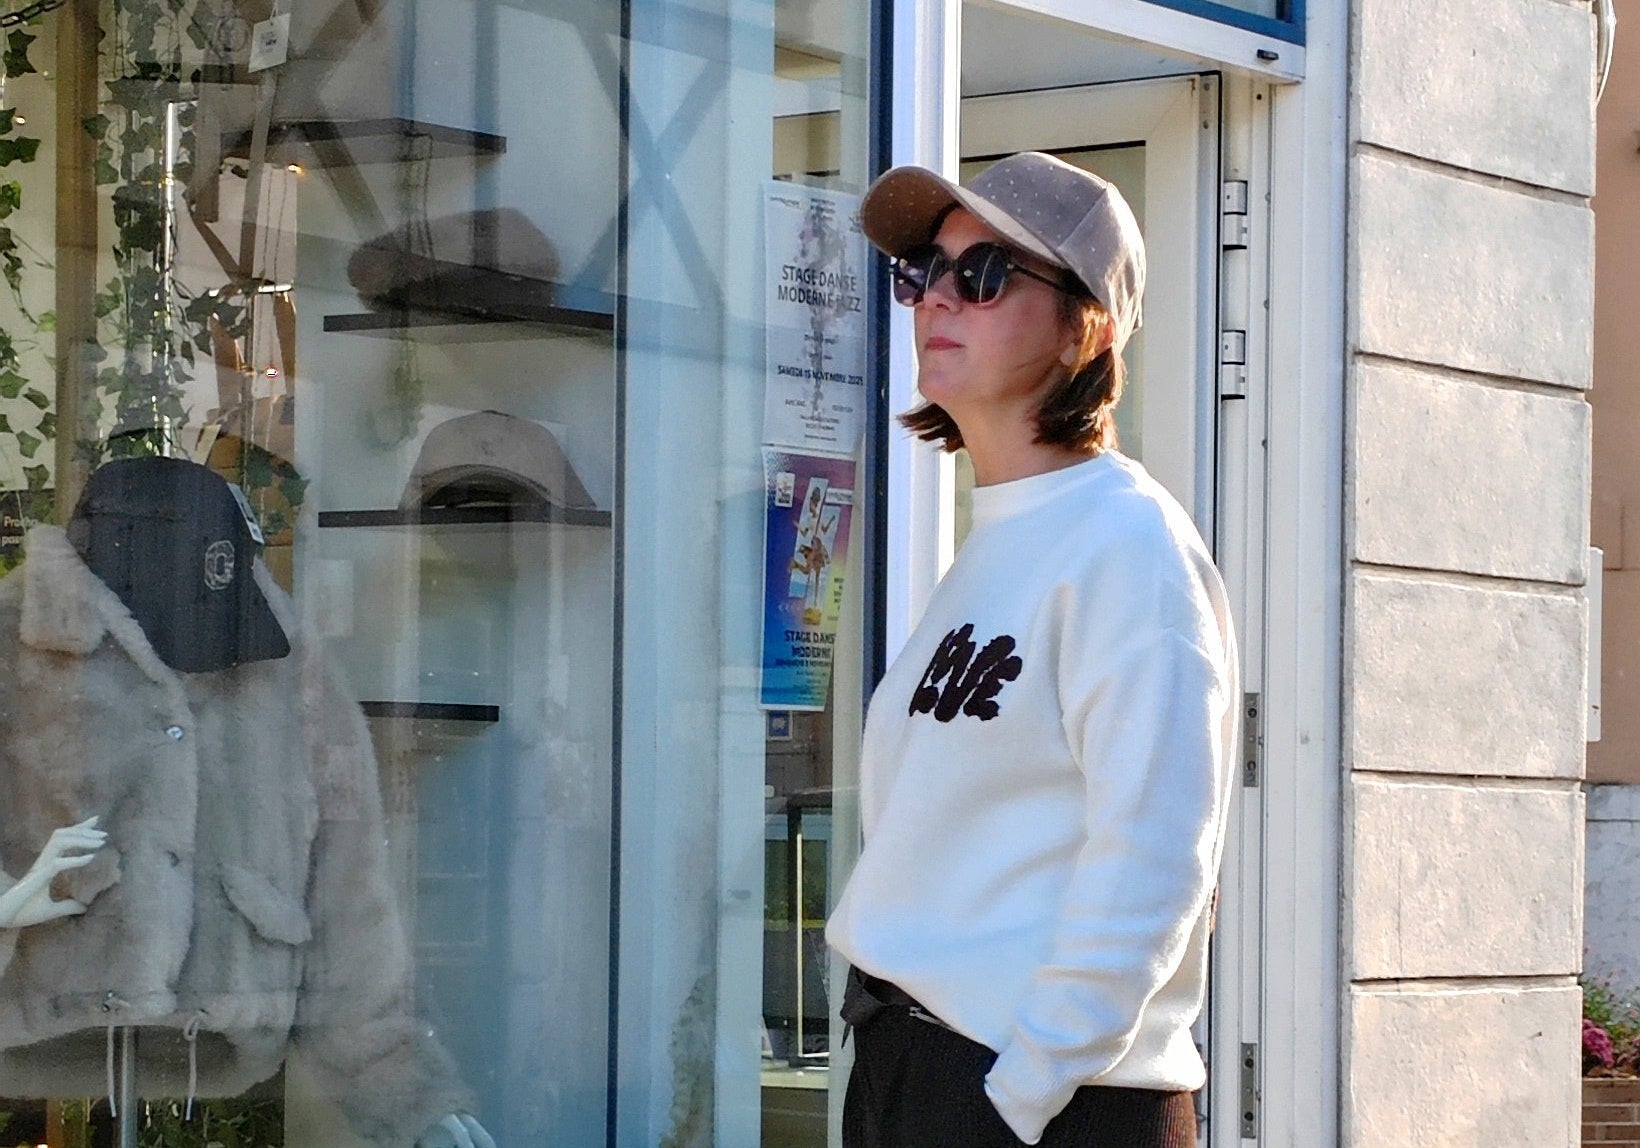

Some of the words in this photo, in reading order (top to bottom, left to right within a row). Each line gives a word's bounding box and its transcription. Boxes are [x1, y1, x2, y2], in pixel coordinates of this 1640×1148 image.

[782, 264, 816, 286] STAGE
[819, 271, 857, 292] DANSE
[778, 284, 833, 308] MODERNE
[812, 632, 836, 645] DANS
